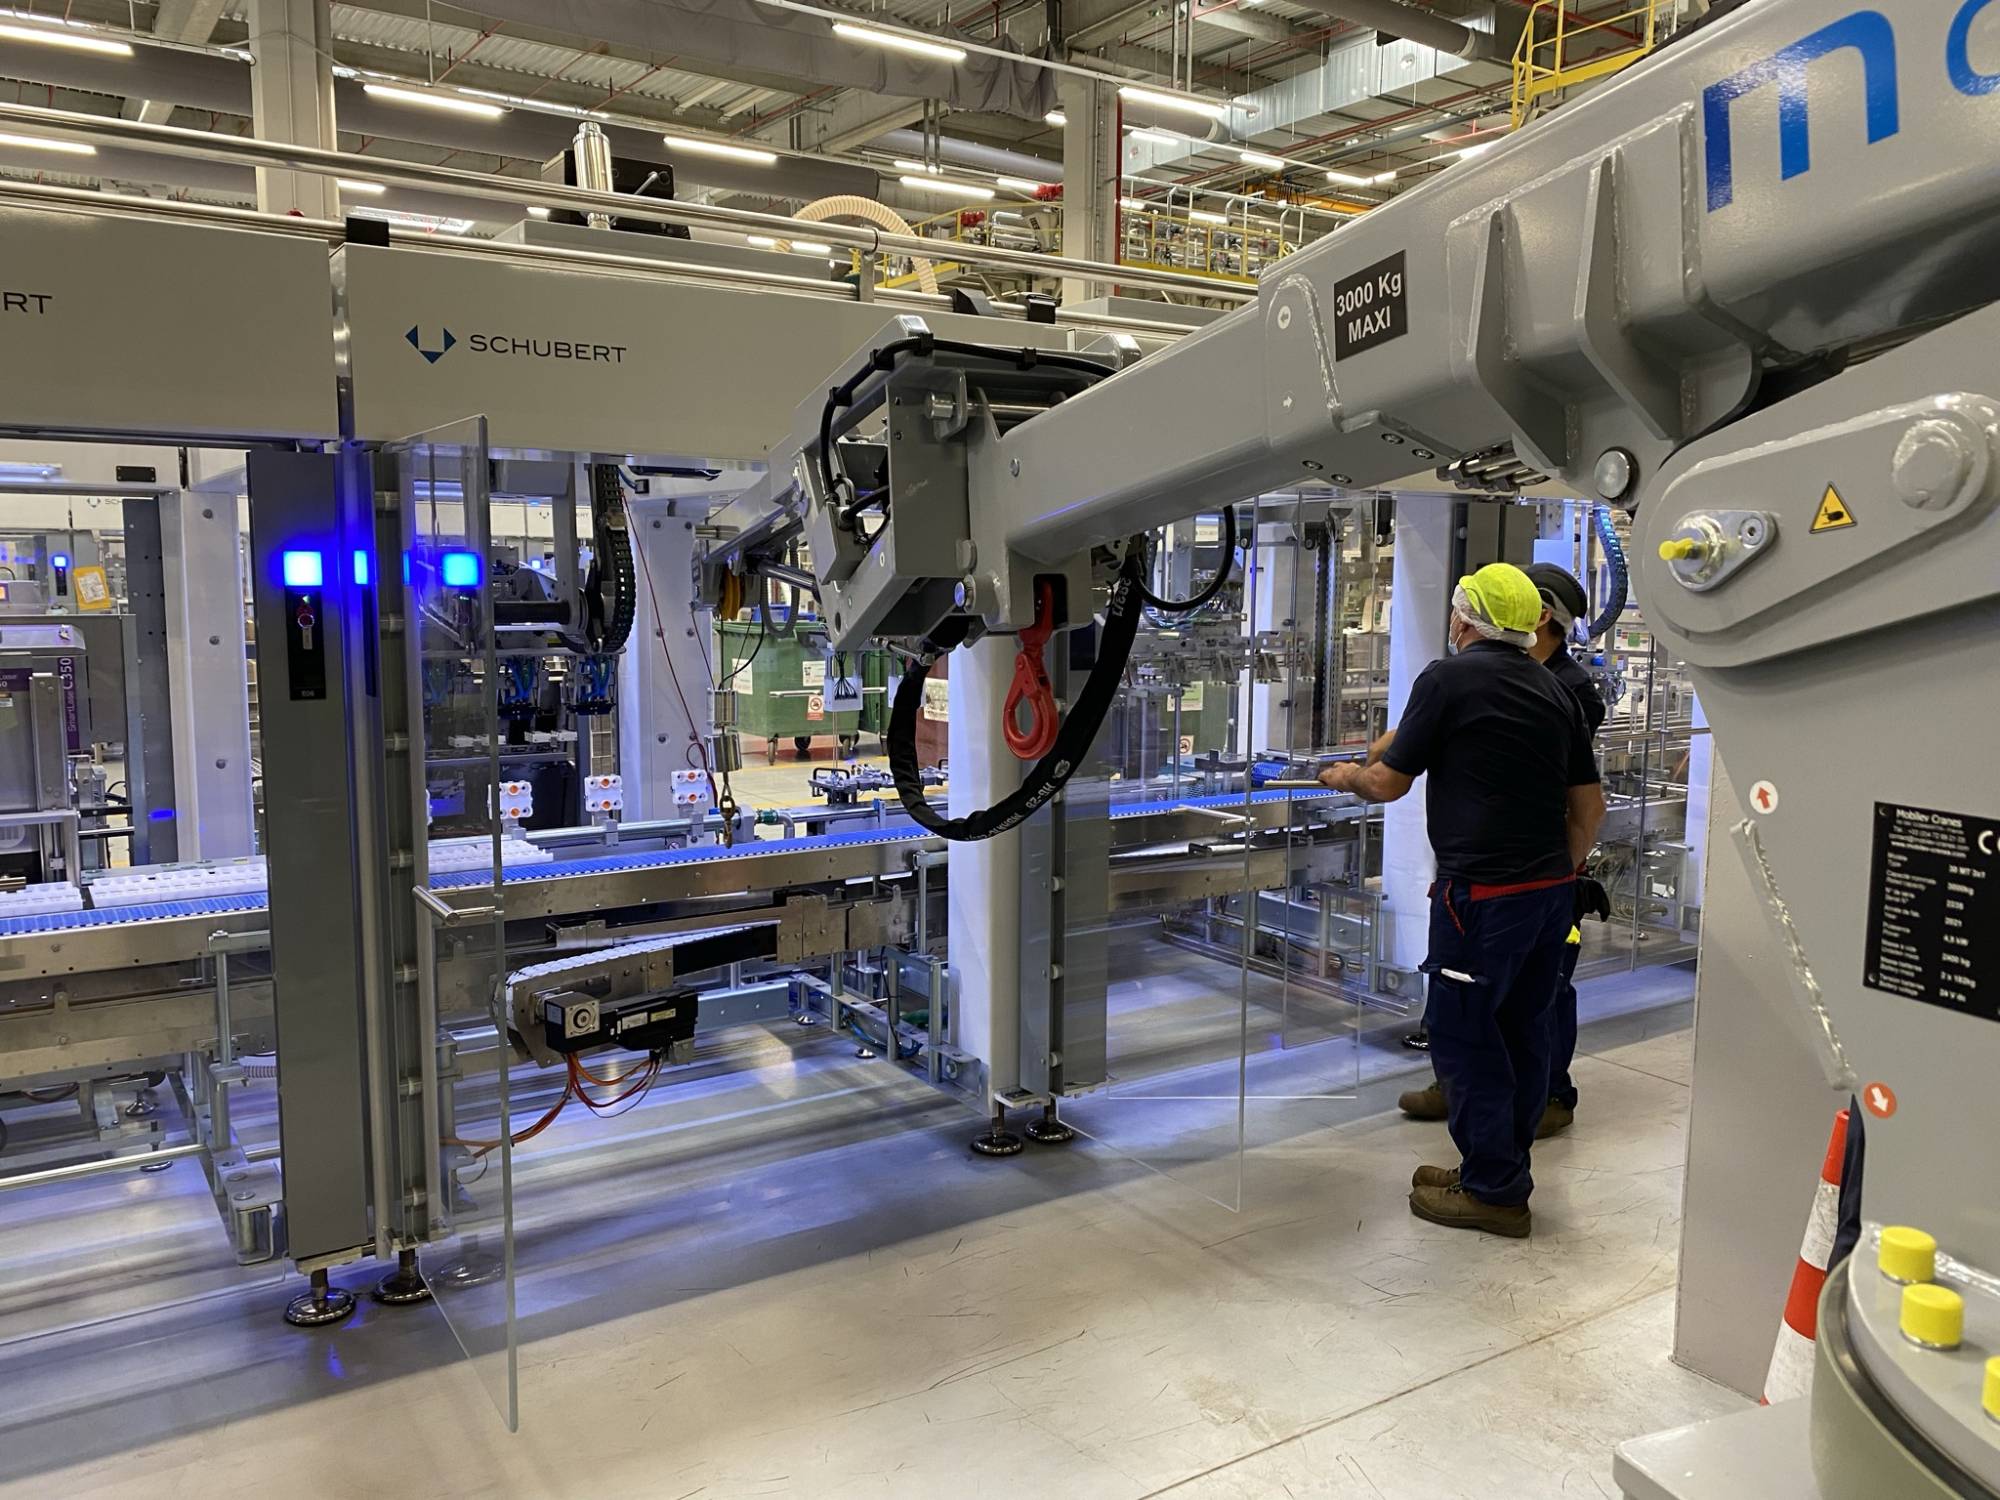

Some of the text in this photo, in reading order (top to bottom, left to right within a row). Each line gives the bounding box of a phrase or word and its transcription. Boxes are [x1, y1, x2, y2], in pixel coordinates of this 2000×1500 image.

[1336, 271, 1402, 317] 3000 Kg
[1347, 305, 1391, 344] MAXI
[469, 334, 628, 363] SCHUBERT
[60, 657, 75, 690] C350
[1896, 808, 1930, 823] Mobilev
[1930, 813, 1963, 829] Cranes
